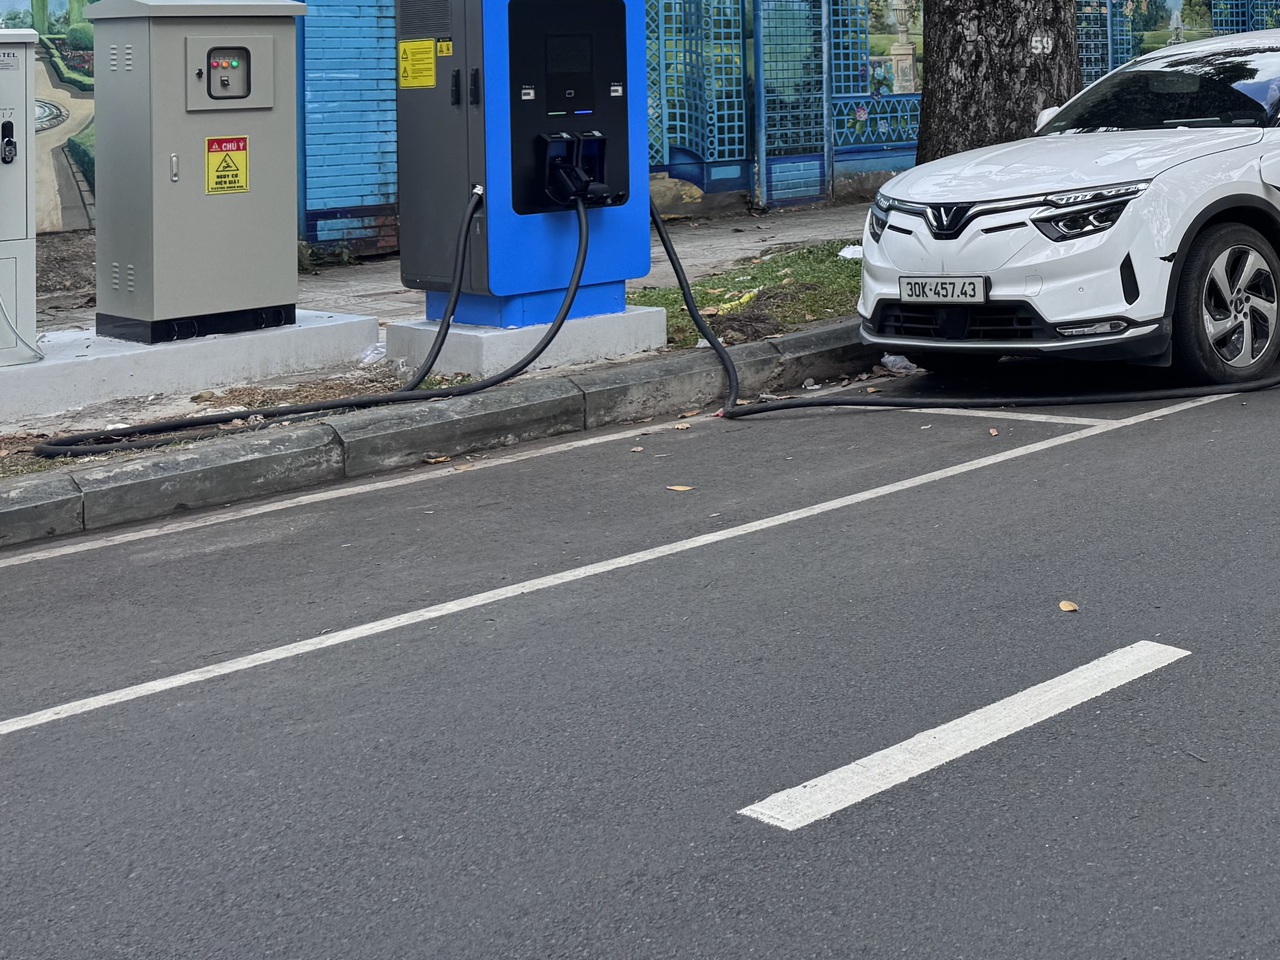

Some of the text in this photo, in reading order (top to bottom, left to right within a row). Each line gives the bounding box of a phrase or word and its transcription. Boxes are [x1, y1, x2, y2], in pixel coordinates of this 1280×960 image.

[1031, 36, 1053, 54] 59
[222, 140, 245, 150] CHÚ Ý
